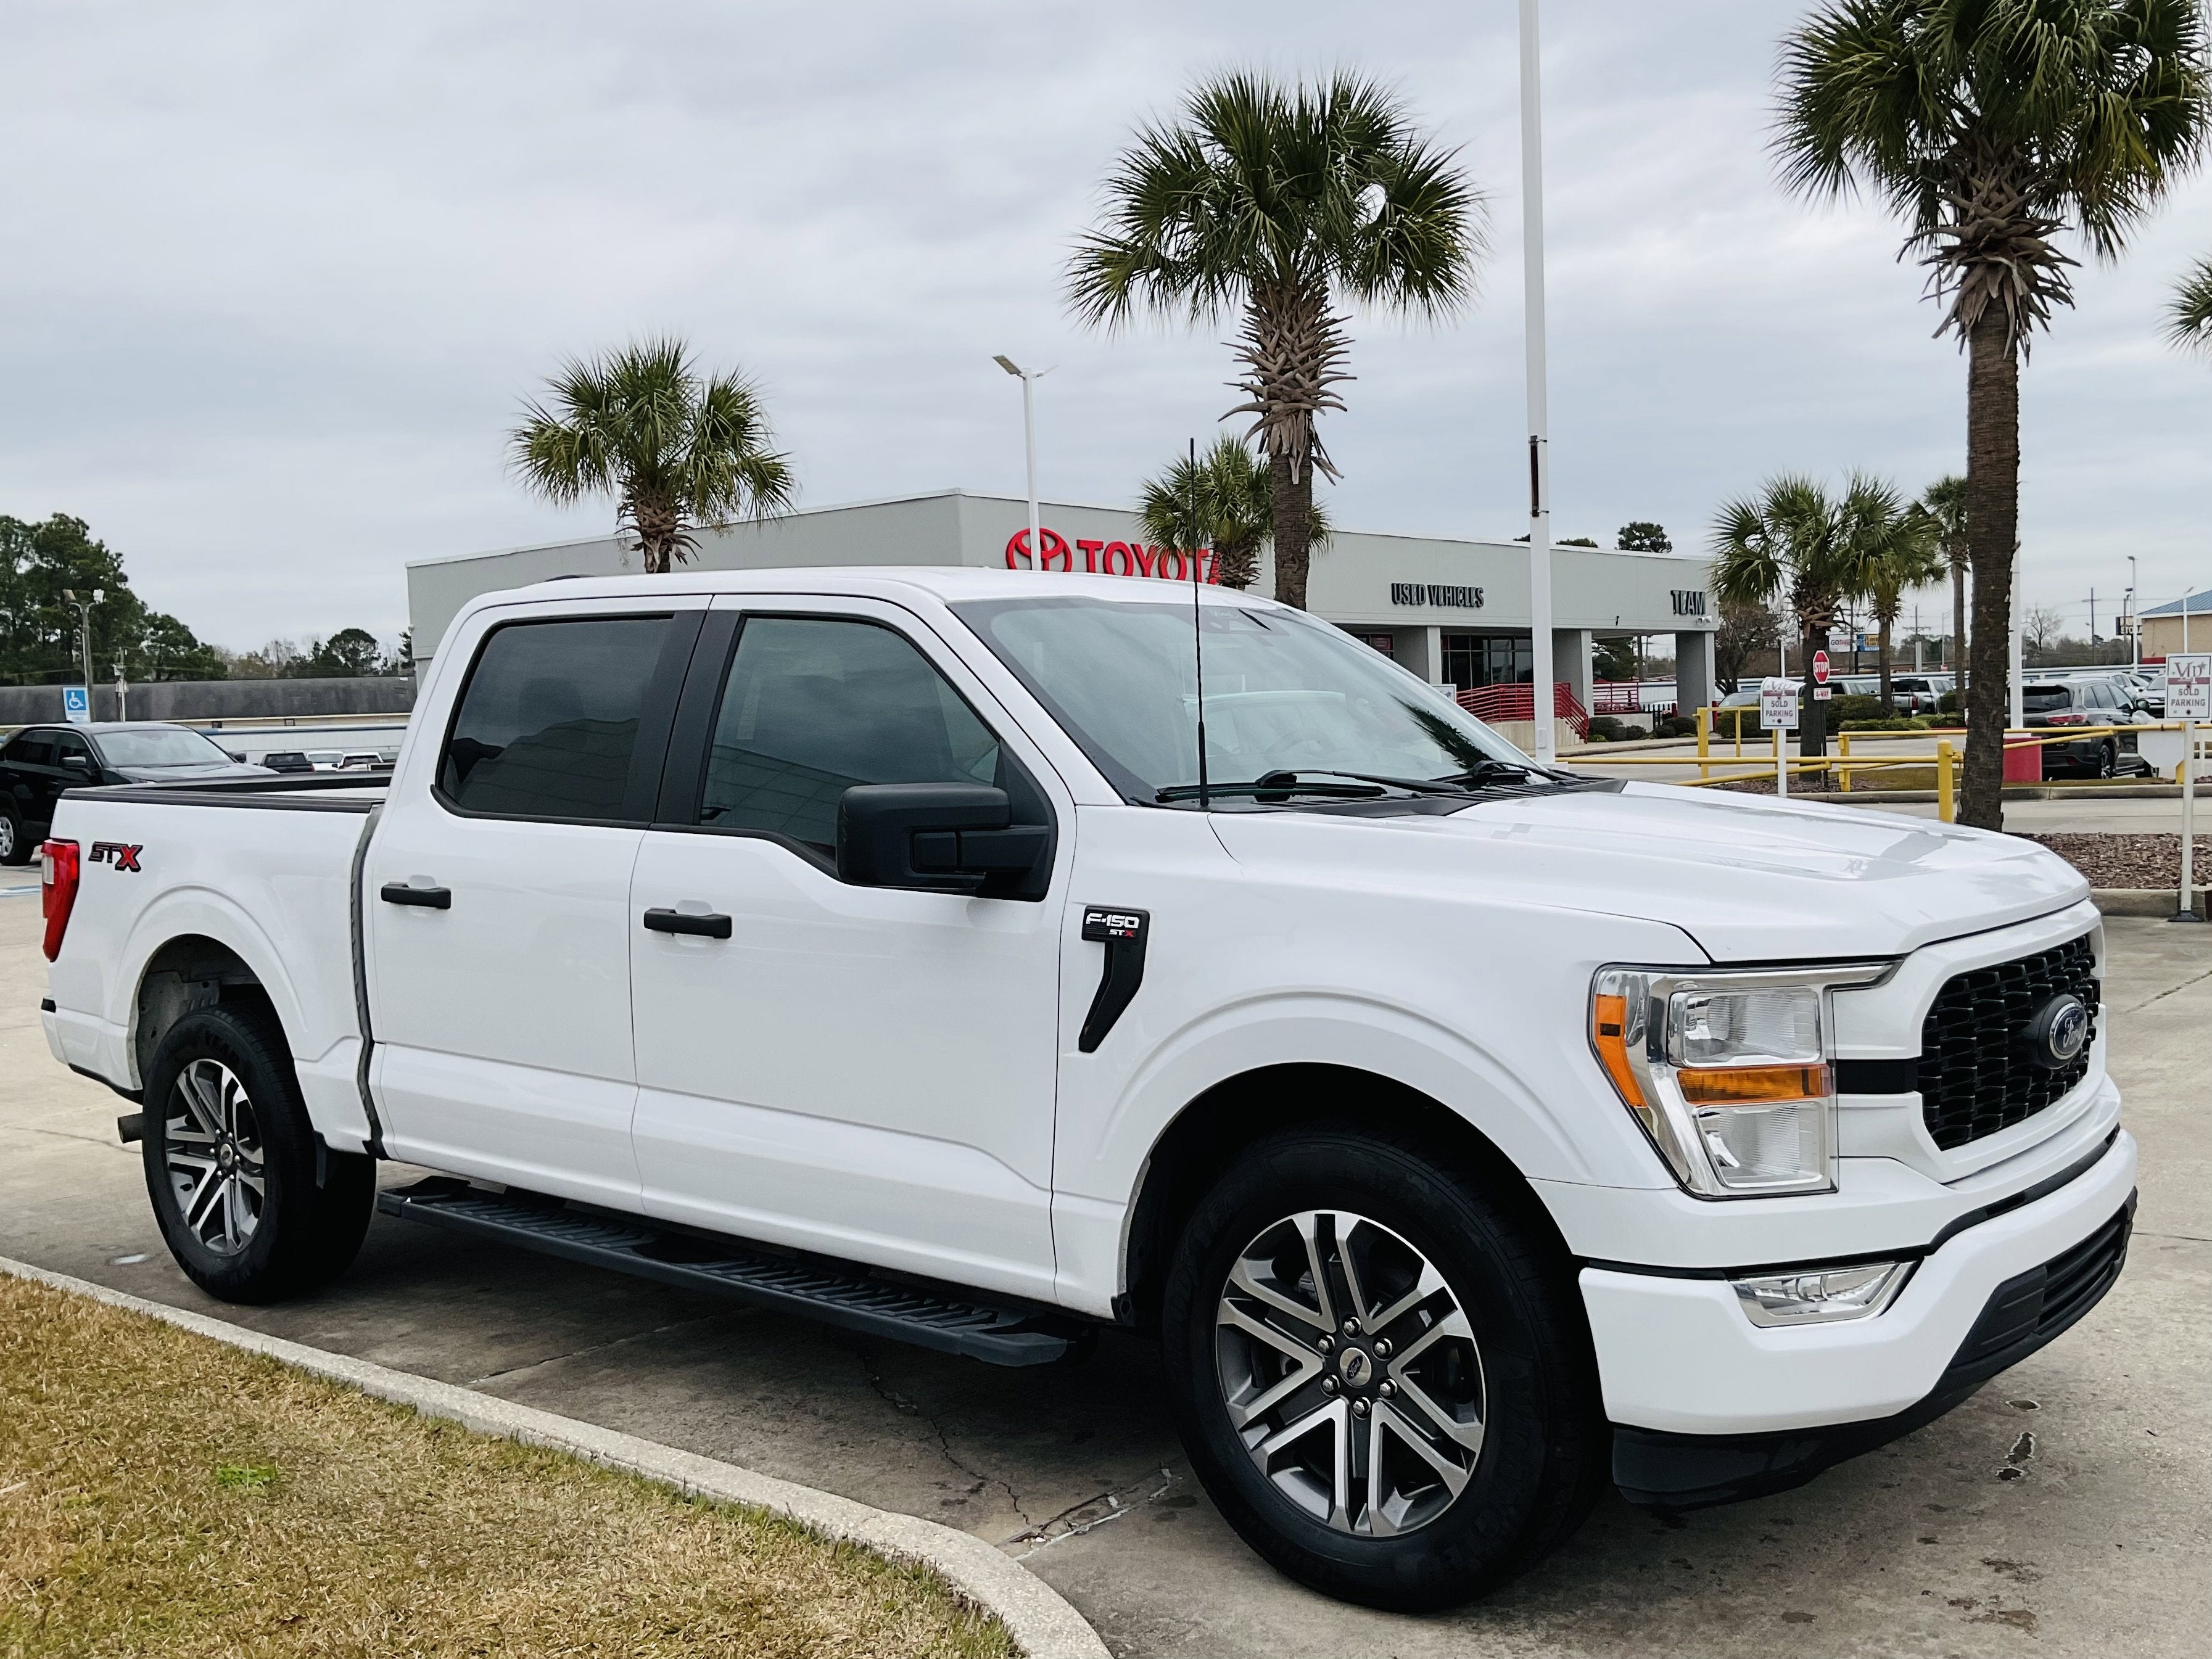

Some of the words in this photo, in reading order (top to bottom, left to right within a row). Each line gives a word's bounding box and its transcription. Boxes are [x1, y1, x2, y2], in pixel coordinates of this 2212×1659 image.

[1391, 583, 1426, 604] USED
[1427, 585, 1484, 607] VEHICLES
[1670, 590, 1706, 615] TEAM
[1814, 661, 1828, 673] STOP
[88, 841, 143, 873] STX
[1086, 913, 1140, 929] F-150
[1109, 929, 1136, 938] STX
[1348, 1359, 1361, 1377] Ford
